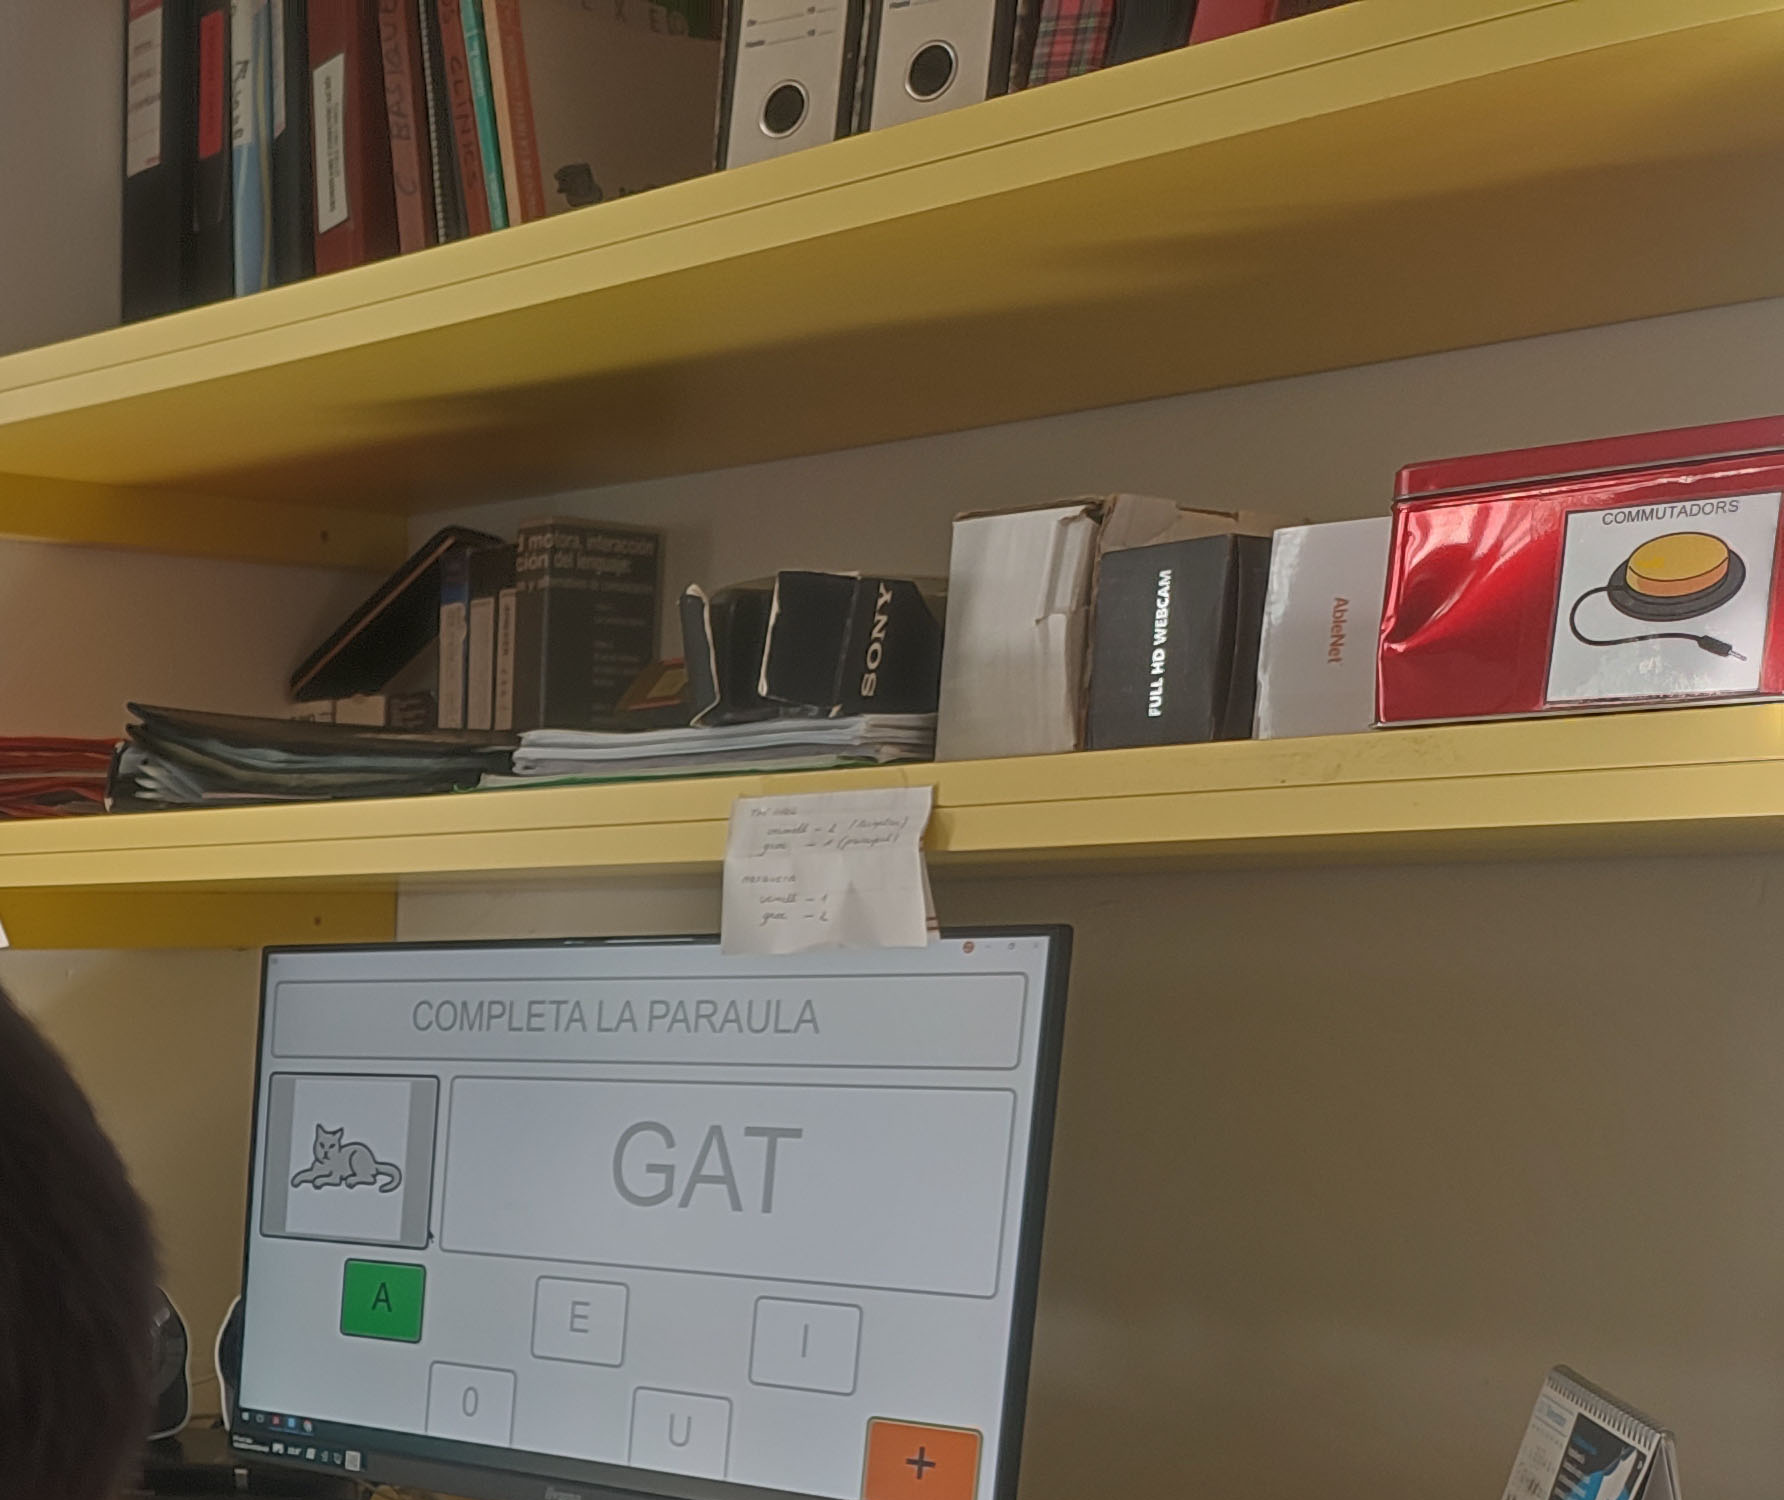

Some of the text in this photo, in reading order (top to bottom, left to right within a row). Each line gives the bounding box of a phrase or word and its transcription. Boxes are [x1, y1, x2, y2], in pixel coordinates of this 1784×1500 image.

[1600, 499, 1739, 527] COMMUTADORS
[860, 580, 893, 697] SONY
[1147, 569, 1173, 718] FULL HD WEBCAM
[1327, 596, 1350, 665] AbleNet
[412, 998, 820, 1037] COMPLETA LA PARAULA
[611, 1118, 804, 1216] GAT
[370, 1281, 393, 1313] A
[569, 1301, 591, 1334] E
[668, 1414, 692, 1449] U
